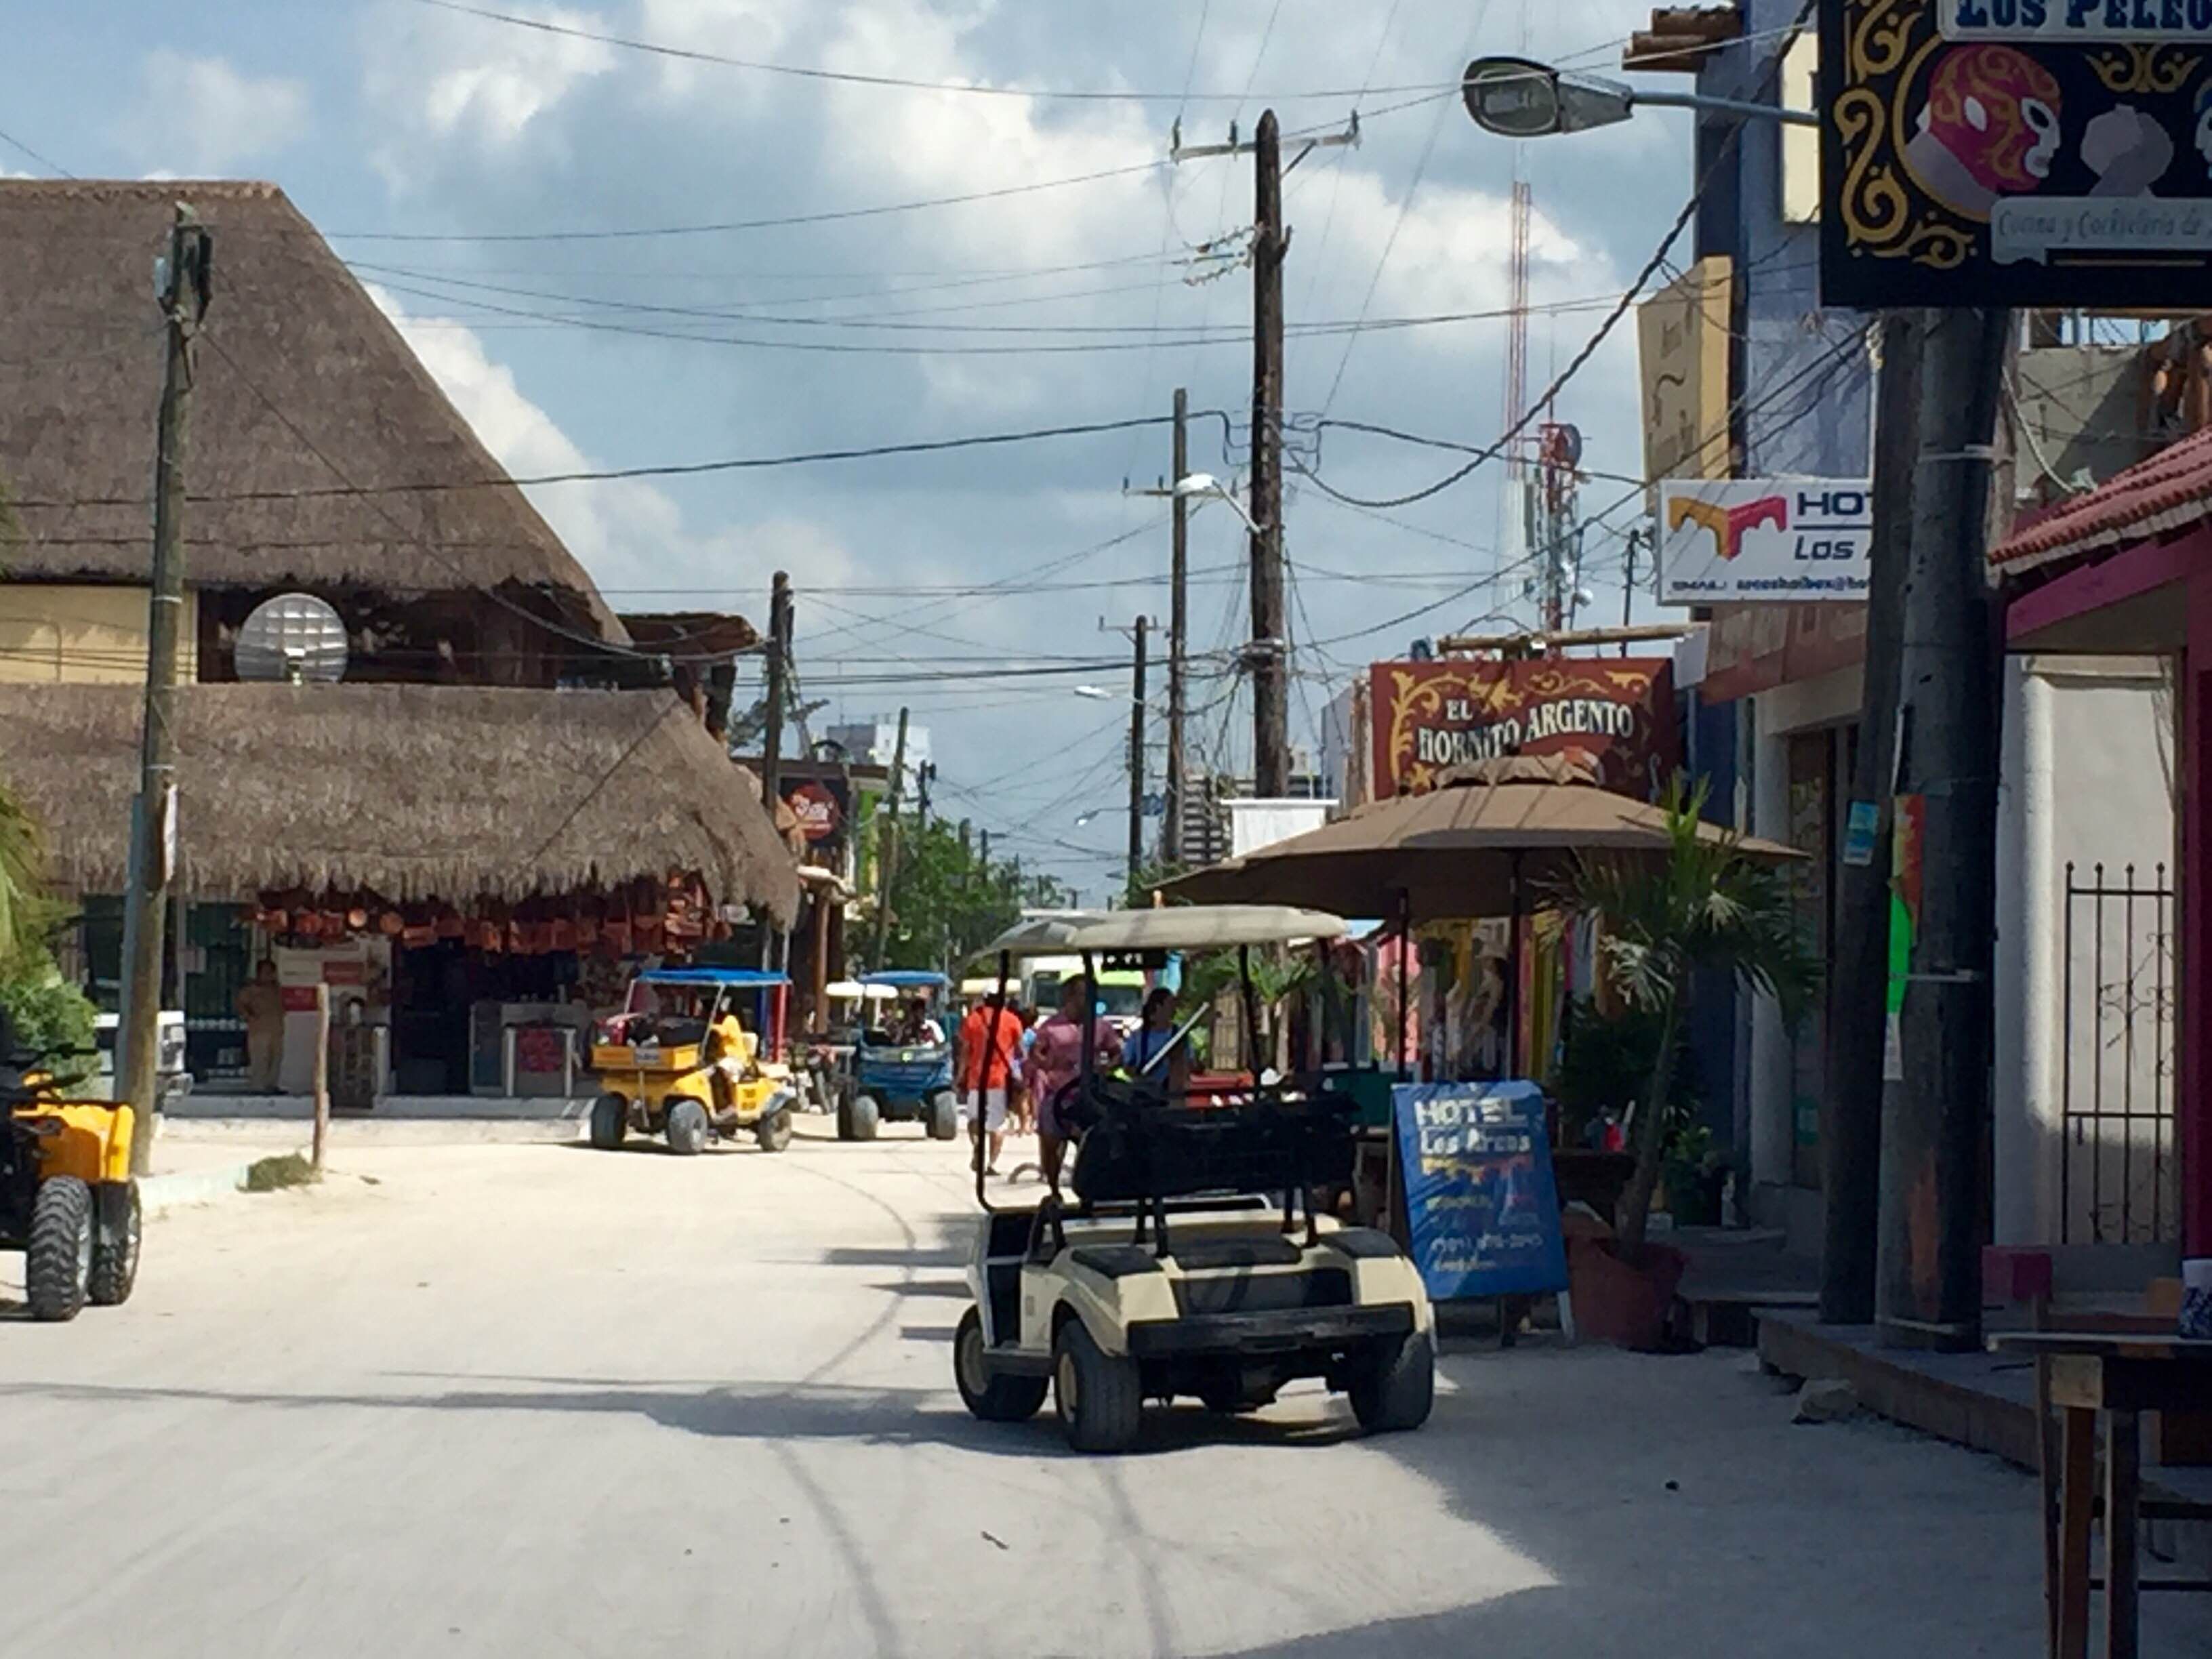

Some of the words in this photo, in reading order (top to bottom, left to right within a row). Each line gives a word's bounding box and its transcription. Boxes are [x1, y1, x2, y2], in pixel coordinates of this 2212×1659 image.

[1955, 0, 2047, 28] LOS
[1446, 699, 1473, 720] EL
[1418, 717, 1520, 764] HORNITO
[1525, 699, 1634, 743] ARGENTO
[1414, 1098, 1528, 1126] HOTEL
